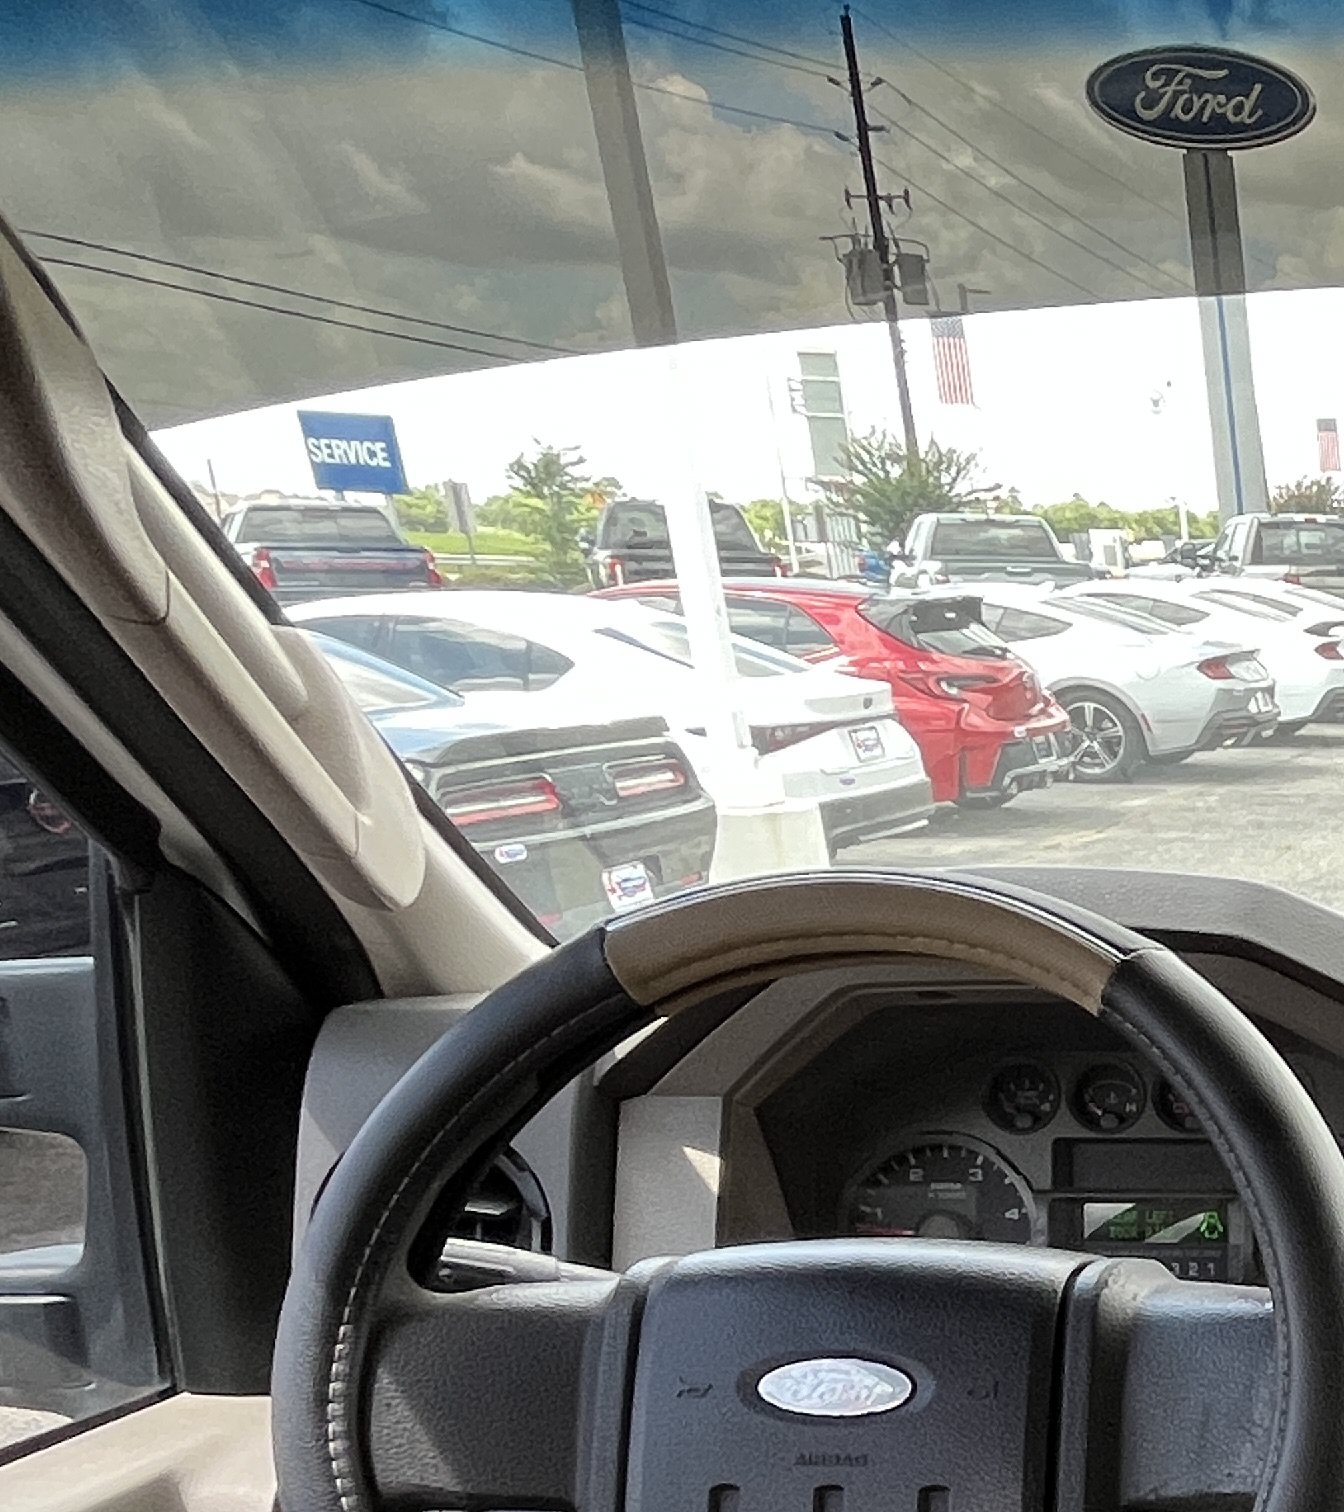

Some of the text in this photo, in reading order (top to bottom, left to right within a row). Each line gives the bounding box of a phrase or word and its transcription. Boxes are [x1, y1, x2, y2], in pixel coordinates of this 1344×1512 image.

[1134, 64, 1264, 124] Ford
[307, 437, 392, 468] SERVICE
[968, 1168, 983, 1182] 3
